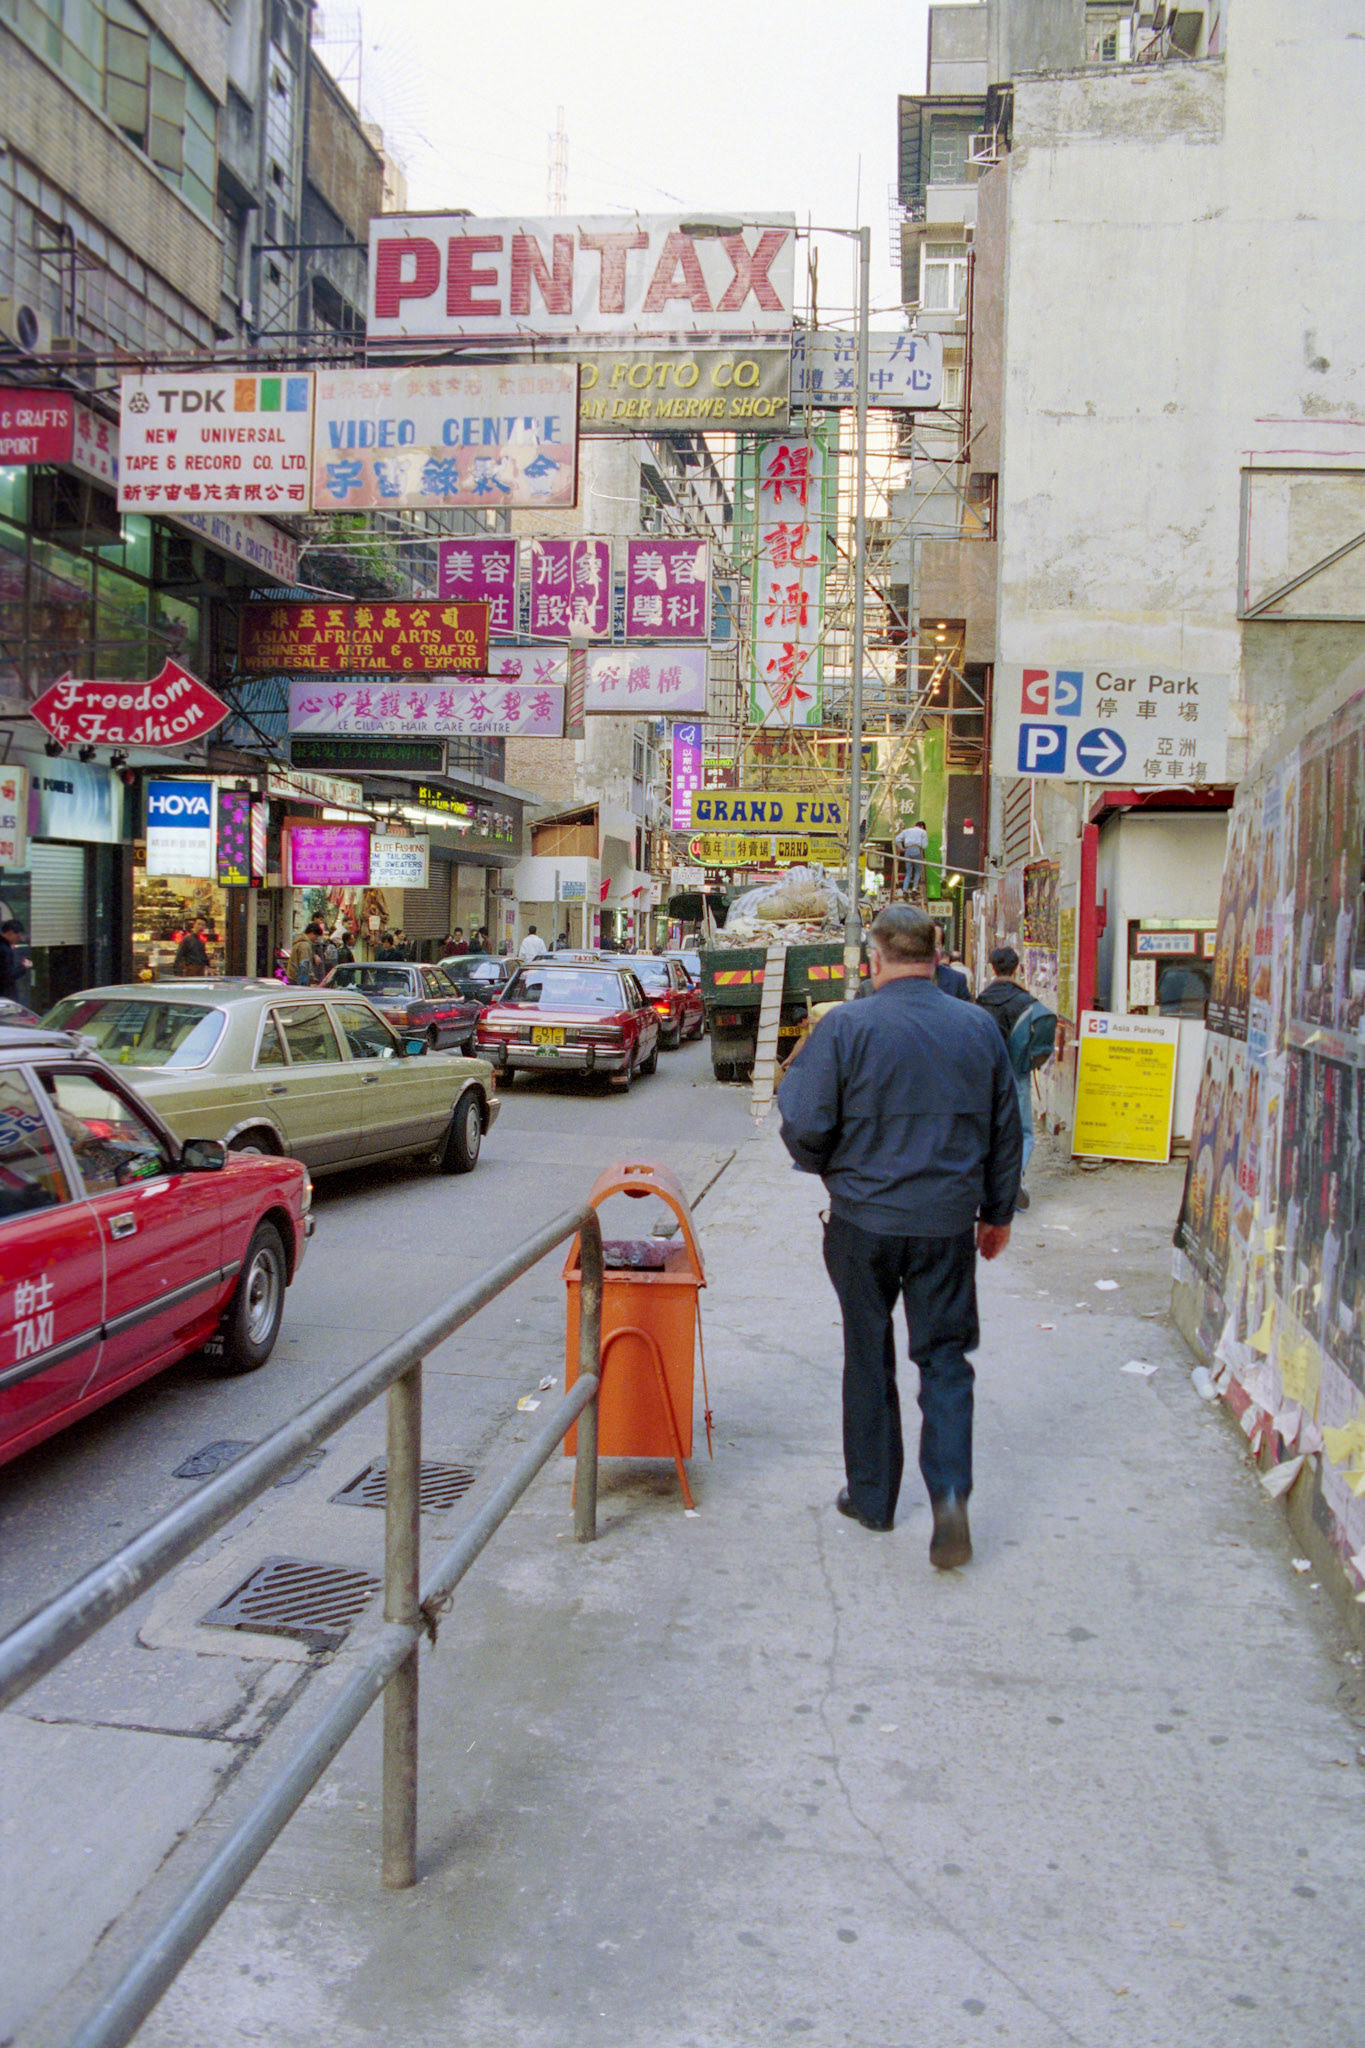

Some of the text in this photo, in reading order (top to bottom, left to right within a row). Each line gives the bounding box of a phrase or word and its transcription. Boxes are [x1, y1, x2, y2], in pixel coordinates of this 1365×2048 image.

[375, 231, 790, 318] PENTAX
[609, 361, 699, 389] FOTO
[712, 360, 761, 388] CO.
[158, 390, 226, 413] TDK
[610, 399, 651, 418] DER
[656, 398, 725, 418] MERWE
[145, 428, 286, 443] NEW UNIVERSAL
[328, 419, 416, 449] VIDEO
[125, 455, 308, 470] TAPE & RECORD CO. LTD.
[445, 551, 511, 584] 美容
[537, 553, 603, 585] 形象
[632, 551, 699, 584] 美容
[761, 445, 819, 708] 得記酒家
[536, 594, 604, 628] 設計
[632, 593, 700, 627] 學科
[252, 629, 479, 643] ASIAN AFRICAN ARTS CO.
[258, 644, 477, 655] CHINESE ARTS & CRAFTS
[245, 657, 482, 669] WHOLESALE RETAIL & EXPORT
[53, 677, 192, 711] Freedom
[1096, 672, 1199, 695] Car Park
[74, 703, 204, 744] Fashion
[338, 720, 511, 733] LE CILLA'S HAIR CARE CENTRE
[1156, 737, 1197, 758] 亞洲
[148, 795, 210, 816] HOYA
[696, 800, 842, 824] GRAND FUR
[374, 842, 425, 853] ELITE FASHIONS
[778, 842, 808, 857] GRAND
[1112, 1023, 1165, 1036] Asia Parking
[14, 1272, 55, 1320] 的士
[13, 1310, 55, 1360] TAXI
